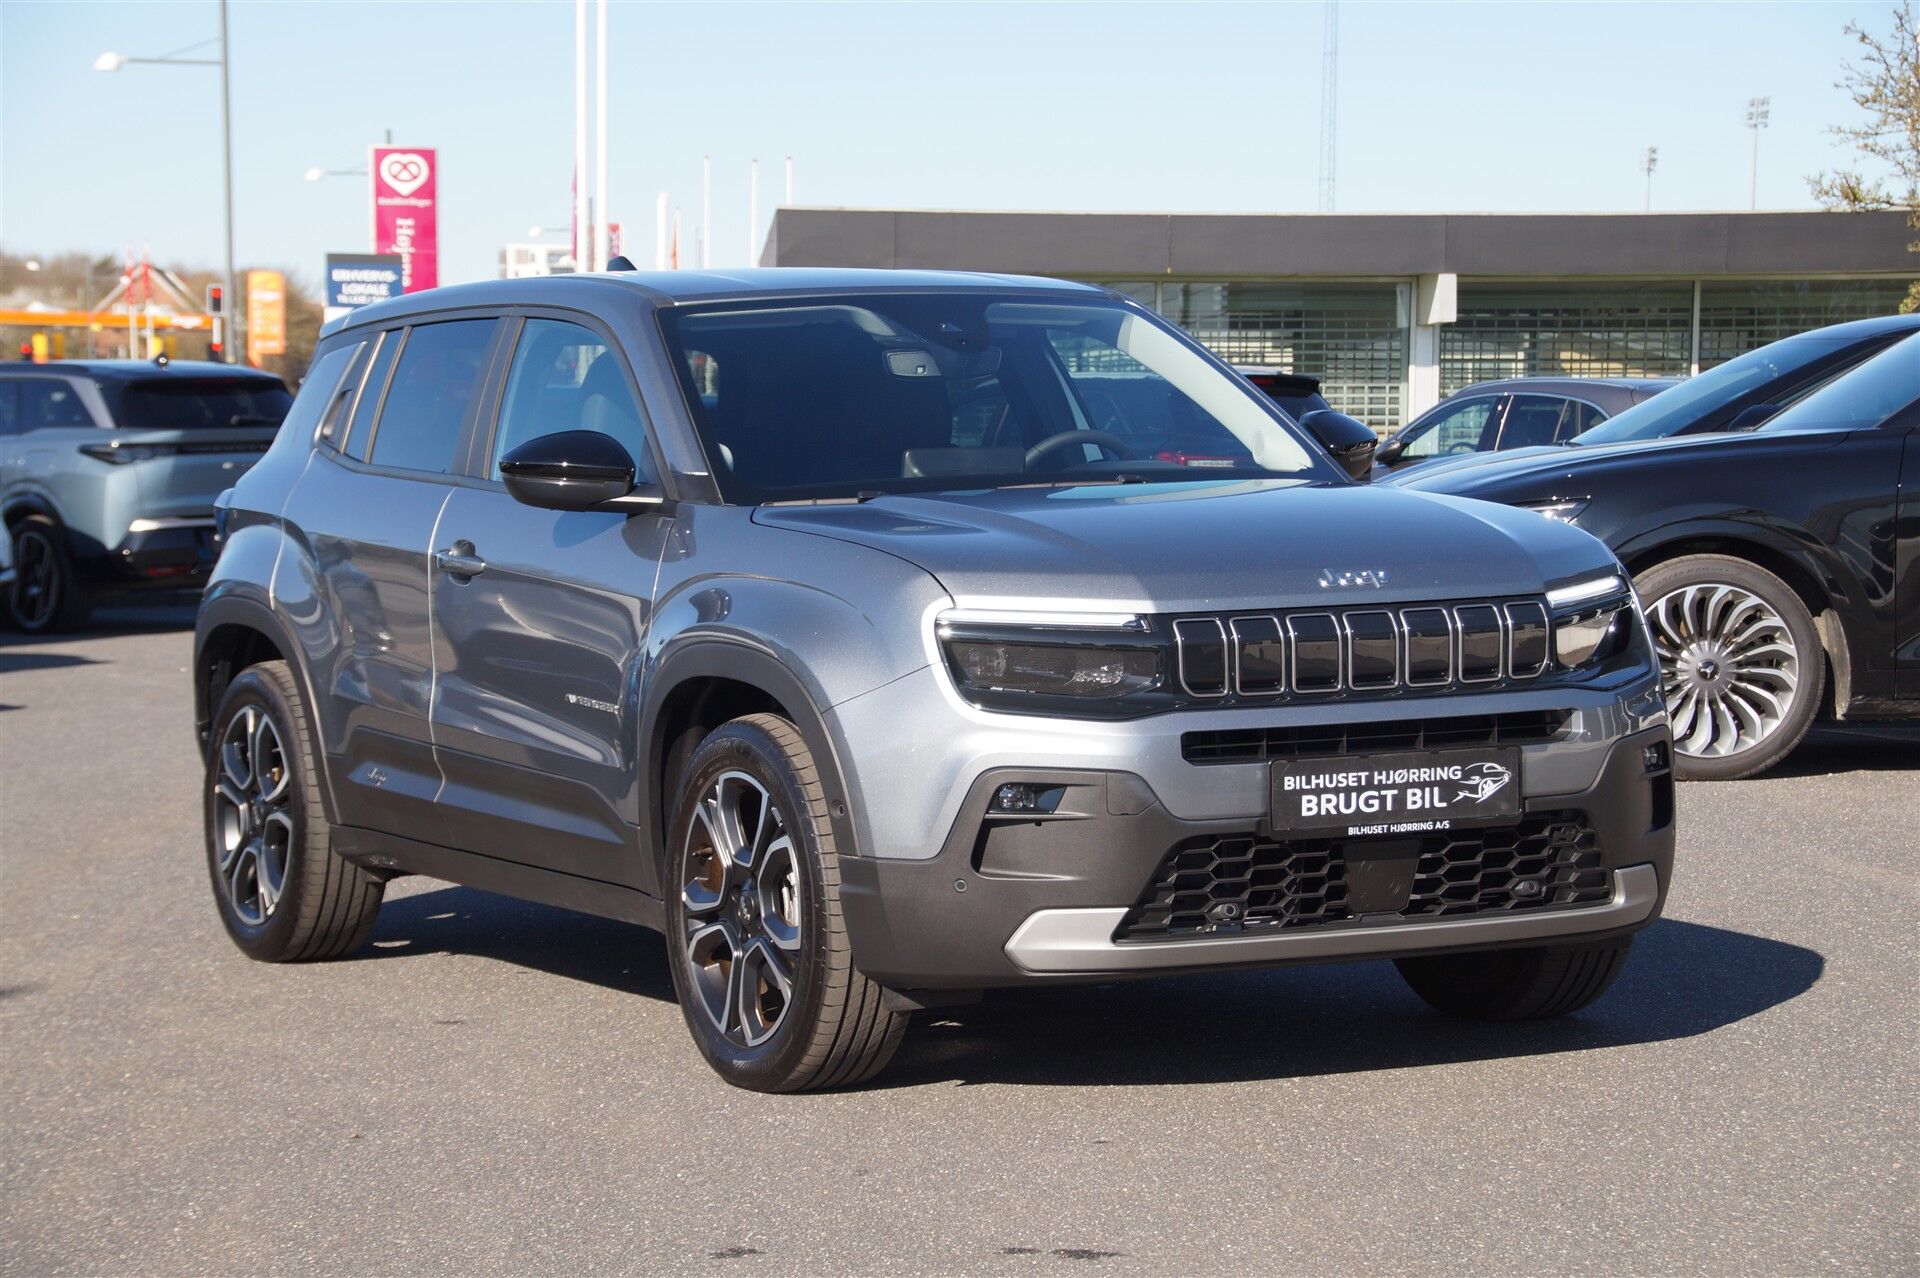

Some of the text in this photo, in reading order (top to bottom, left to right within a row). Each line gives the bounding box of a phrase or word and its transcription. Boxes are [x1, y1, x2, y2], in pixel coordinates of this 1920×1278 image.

[1284, 765, 1462, 791] BILHUSET HJØRRING
[1301, 786, 1447, 817] BRUGT BIL
[1348, 820, 1450, 836] BILHUSET HJØRRING A/S
